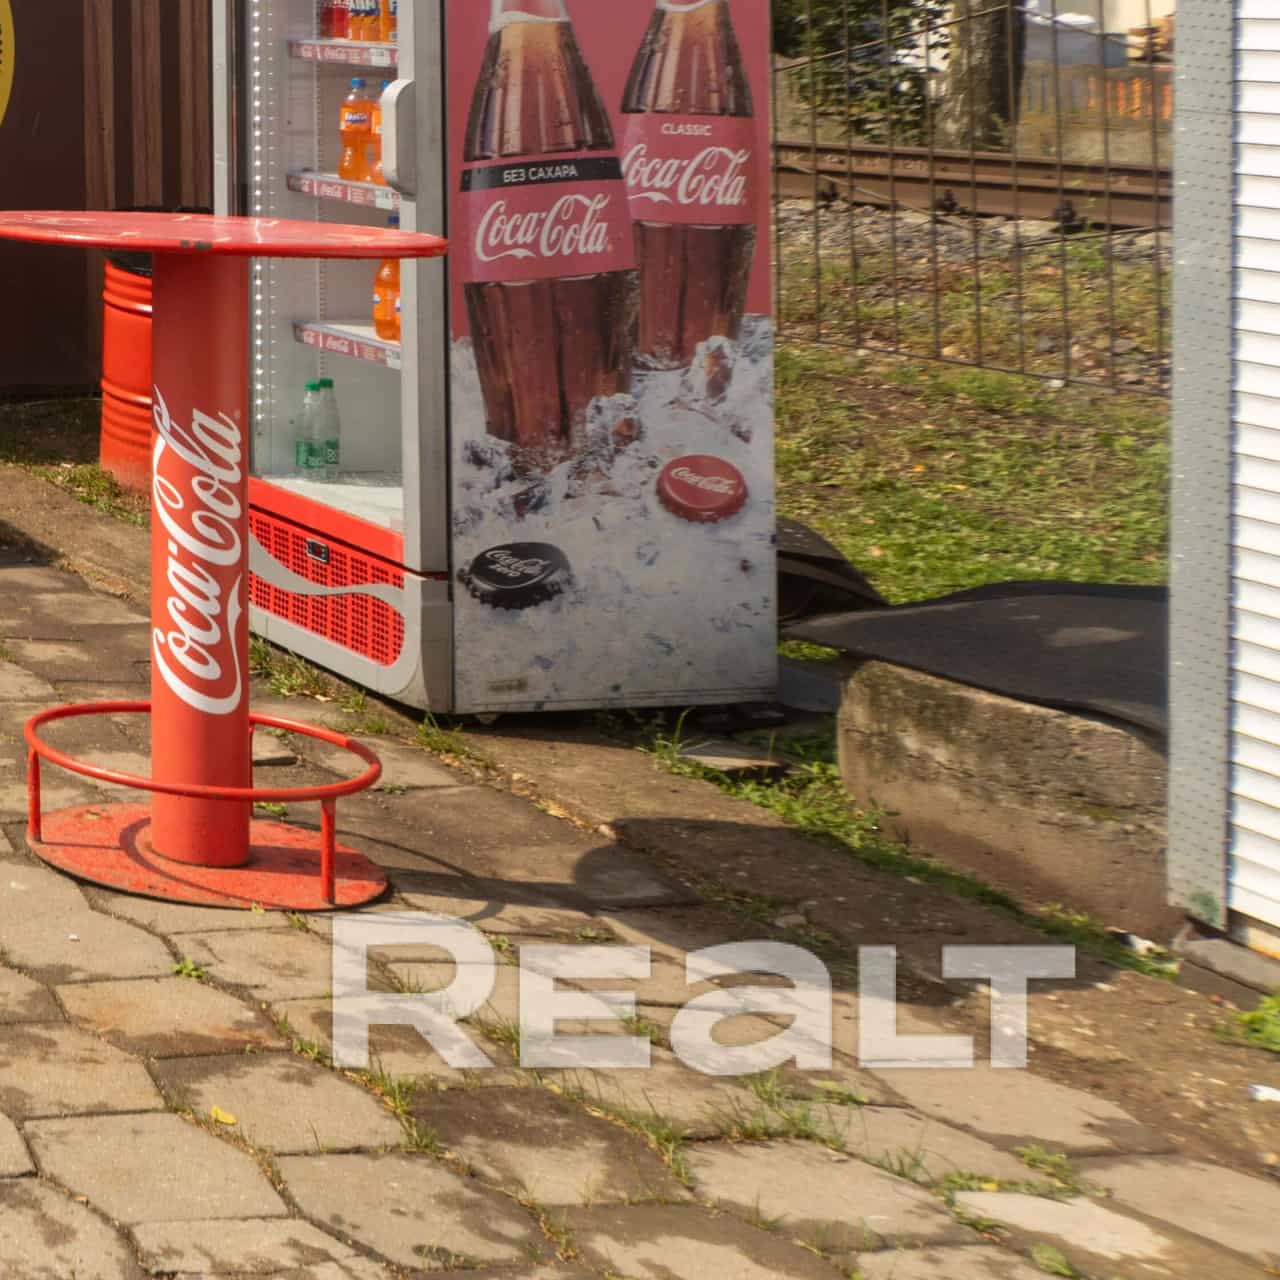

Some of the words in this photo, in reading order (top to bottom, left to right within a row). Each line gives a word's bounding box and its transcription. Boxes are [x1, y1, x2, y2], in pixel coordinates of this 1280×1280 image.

[662, 123, 712, 136] CLASSIC
[503, 169, 526, 183] БЕЗ
[528, 164, 578, 180] САХАРА
[475, 193, 610, 261] Coca-Cola
[153, 384, 241, 714] Coca-Cola
